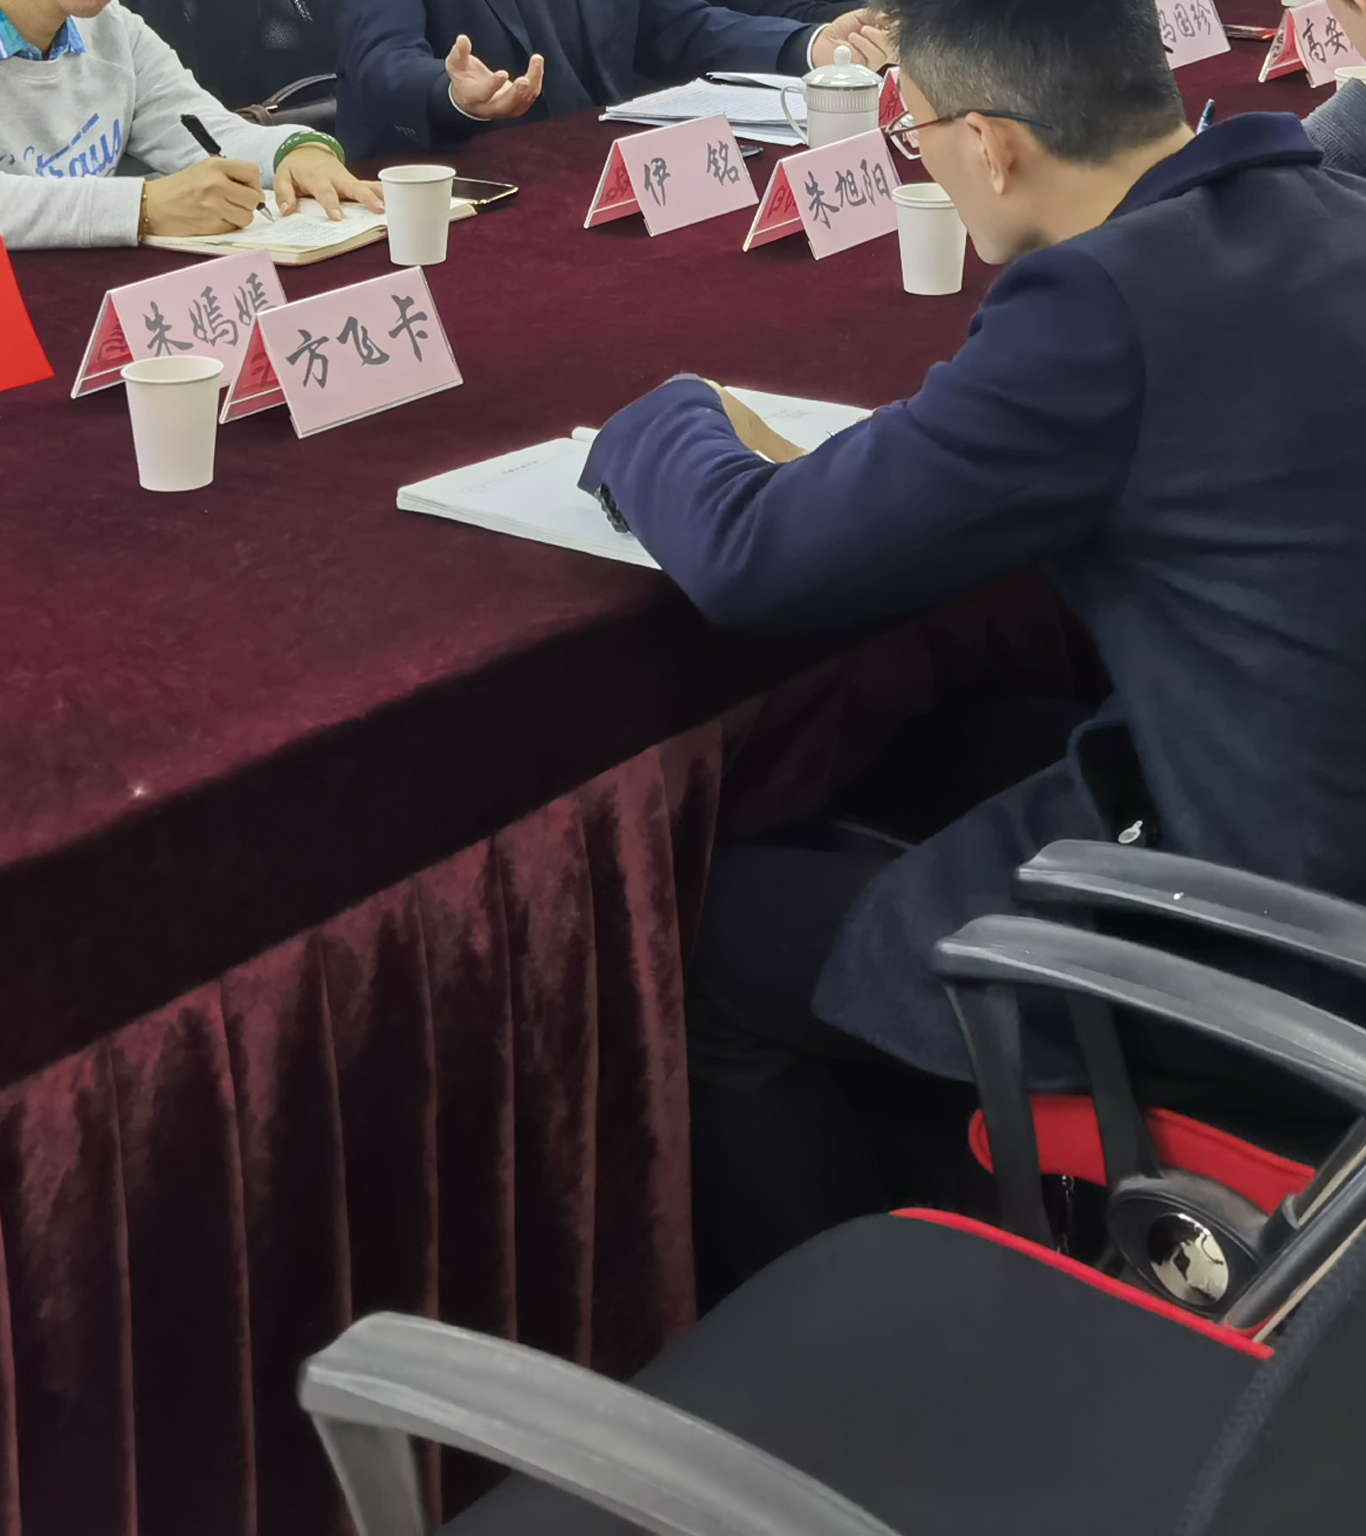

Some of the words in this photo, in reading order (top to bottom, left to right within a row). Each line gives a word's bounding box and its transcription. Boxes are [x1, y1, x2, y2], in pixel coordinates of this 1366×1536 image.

[803, 158, 892, 230] 朱旭阳
[286, 294, 429, 390] 方飞卡
